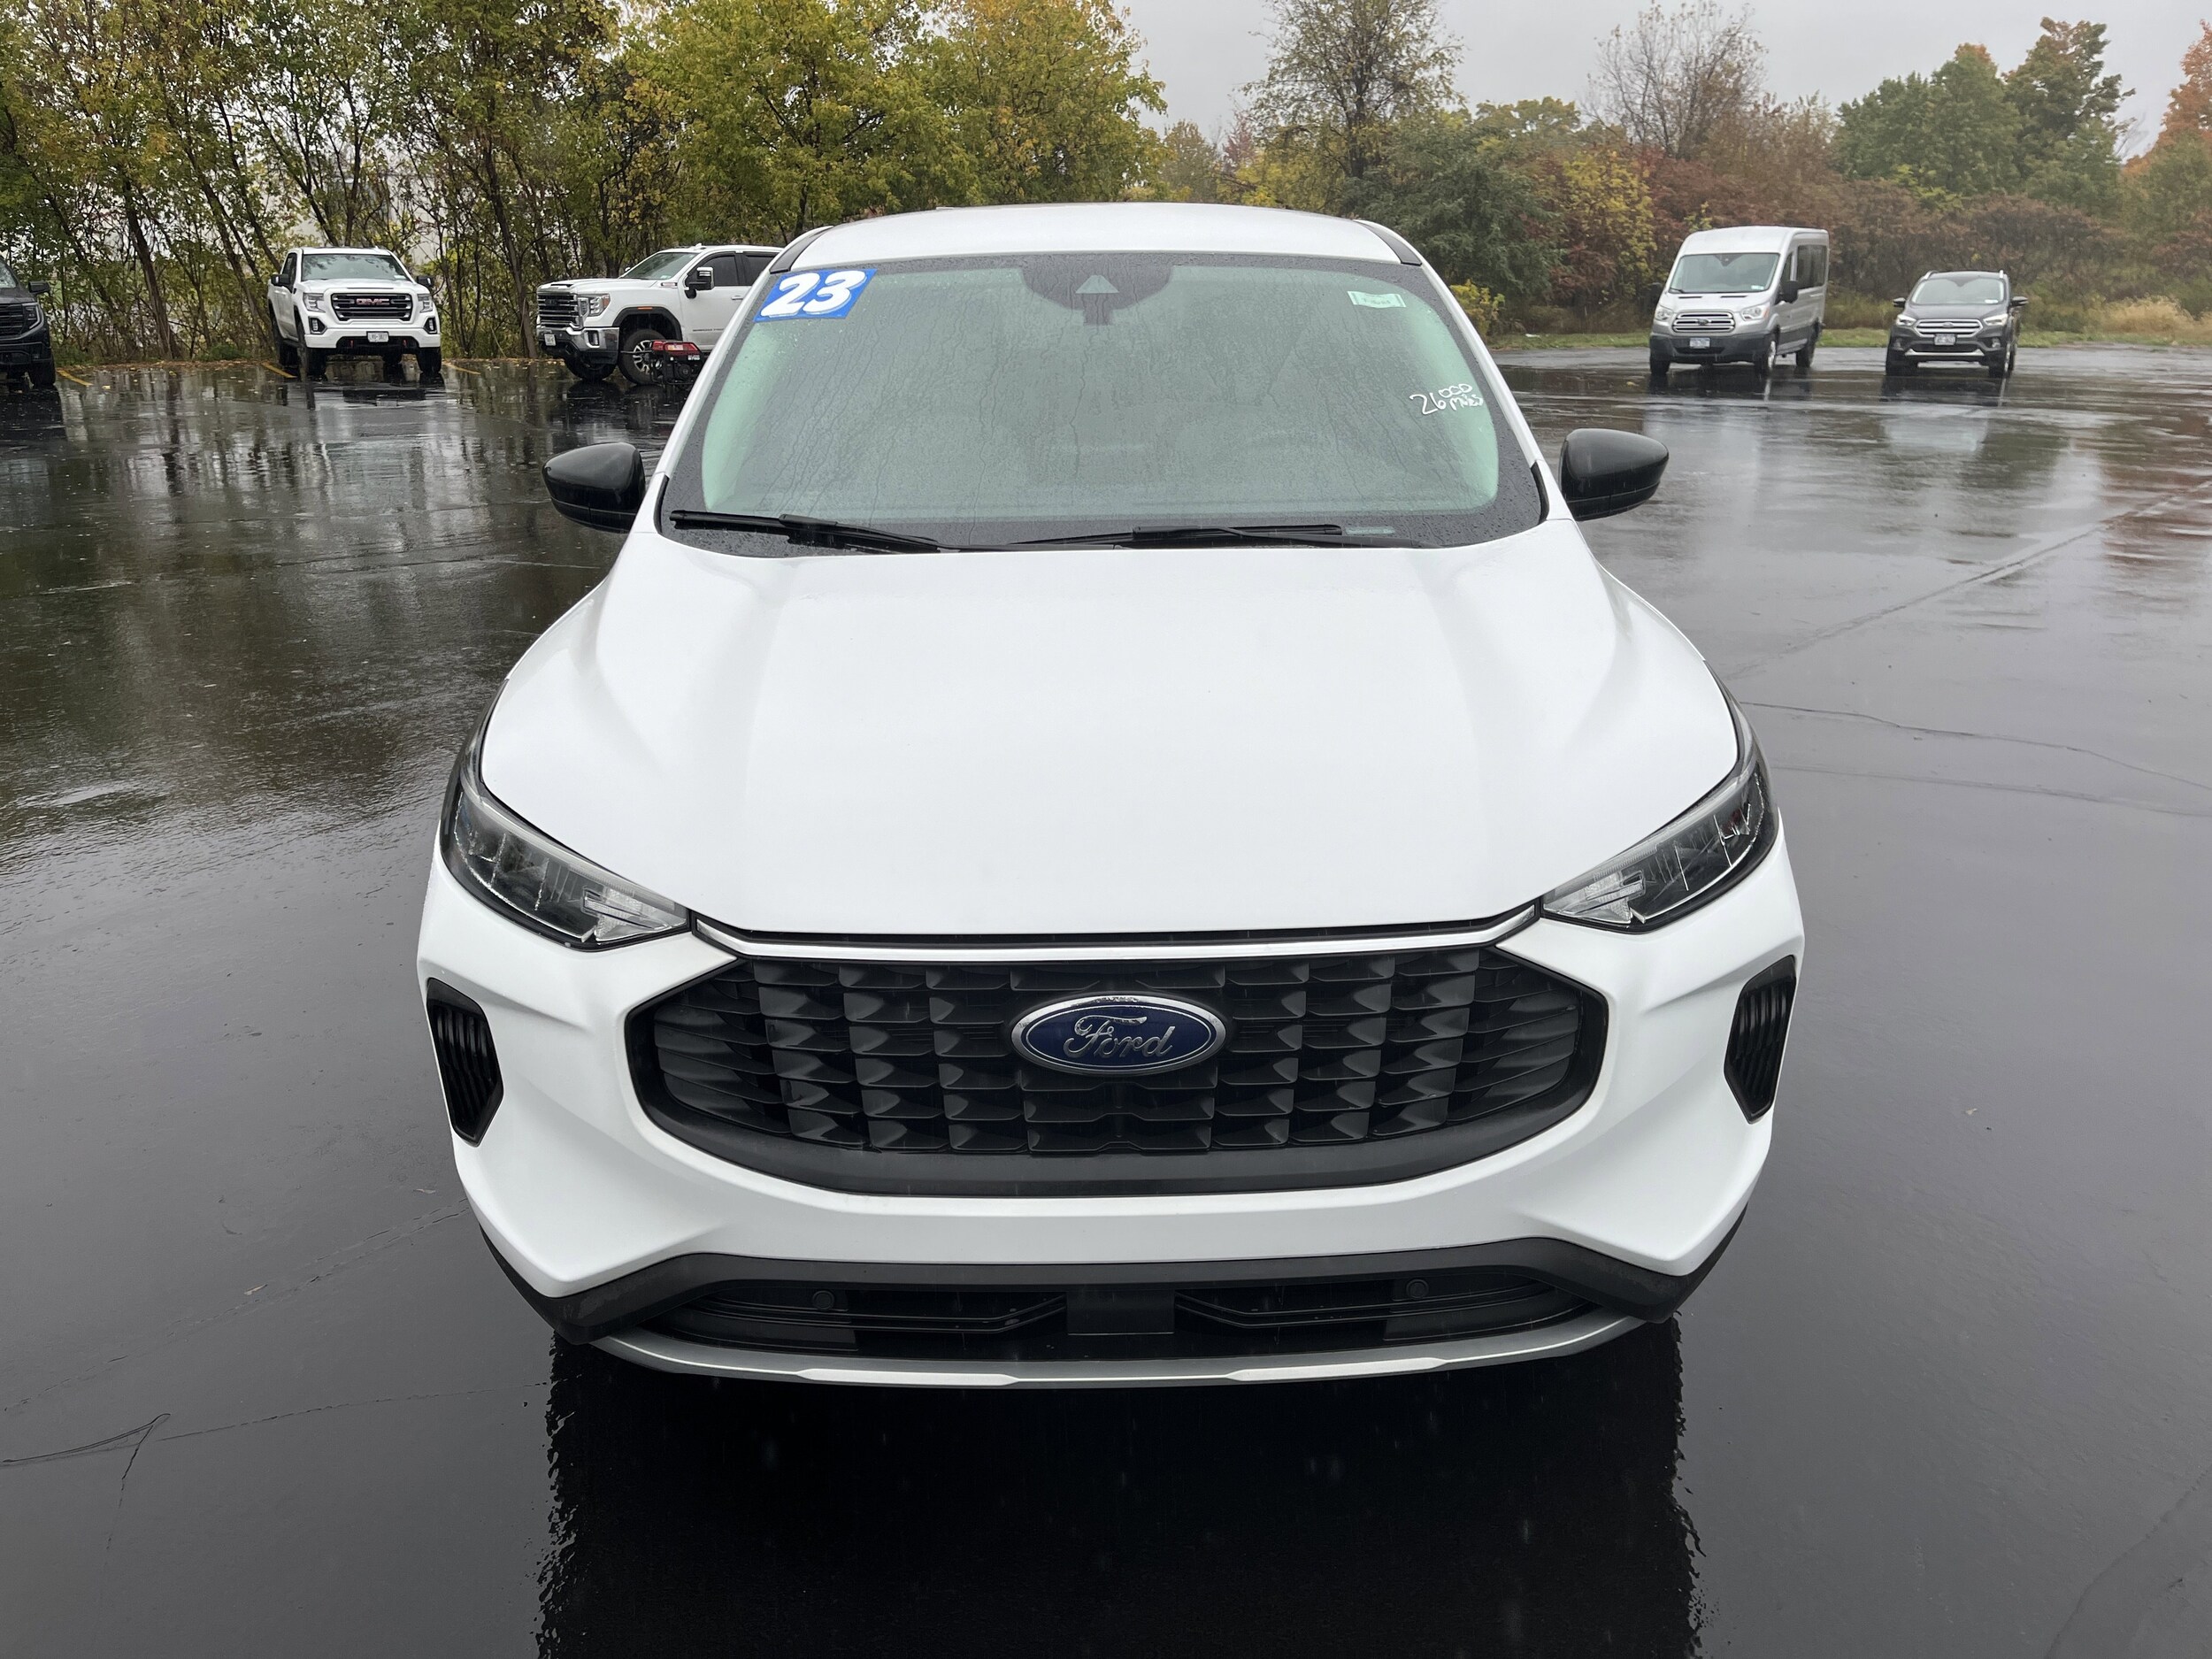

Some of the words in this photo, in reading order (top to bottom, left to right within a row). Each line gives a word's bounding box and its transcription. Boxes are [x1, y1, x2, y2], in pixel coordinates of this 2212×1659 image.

[760, 270, 867, 319] 23
[1409, 392, 1447, 415] 26
[1063, 1015, 1176, 1058] Ford
